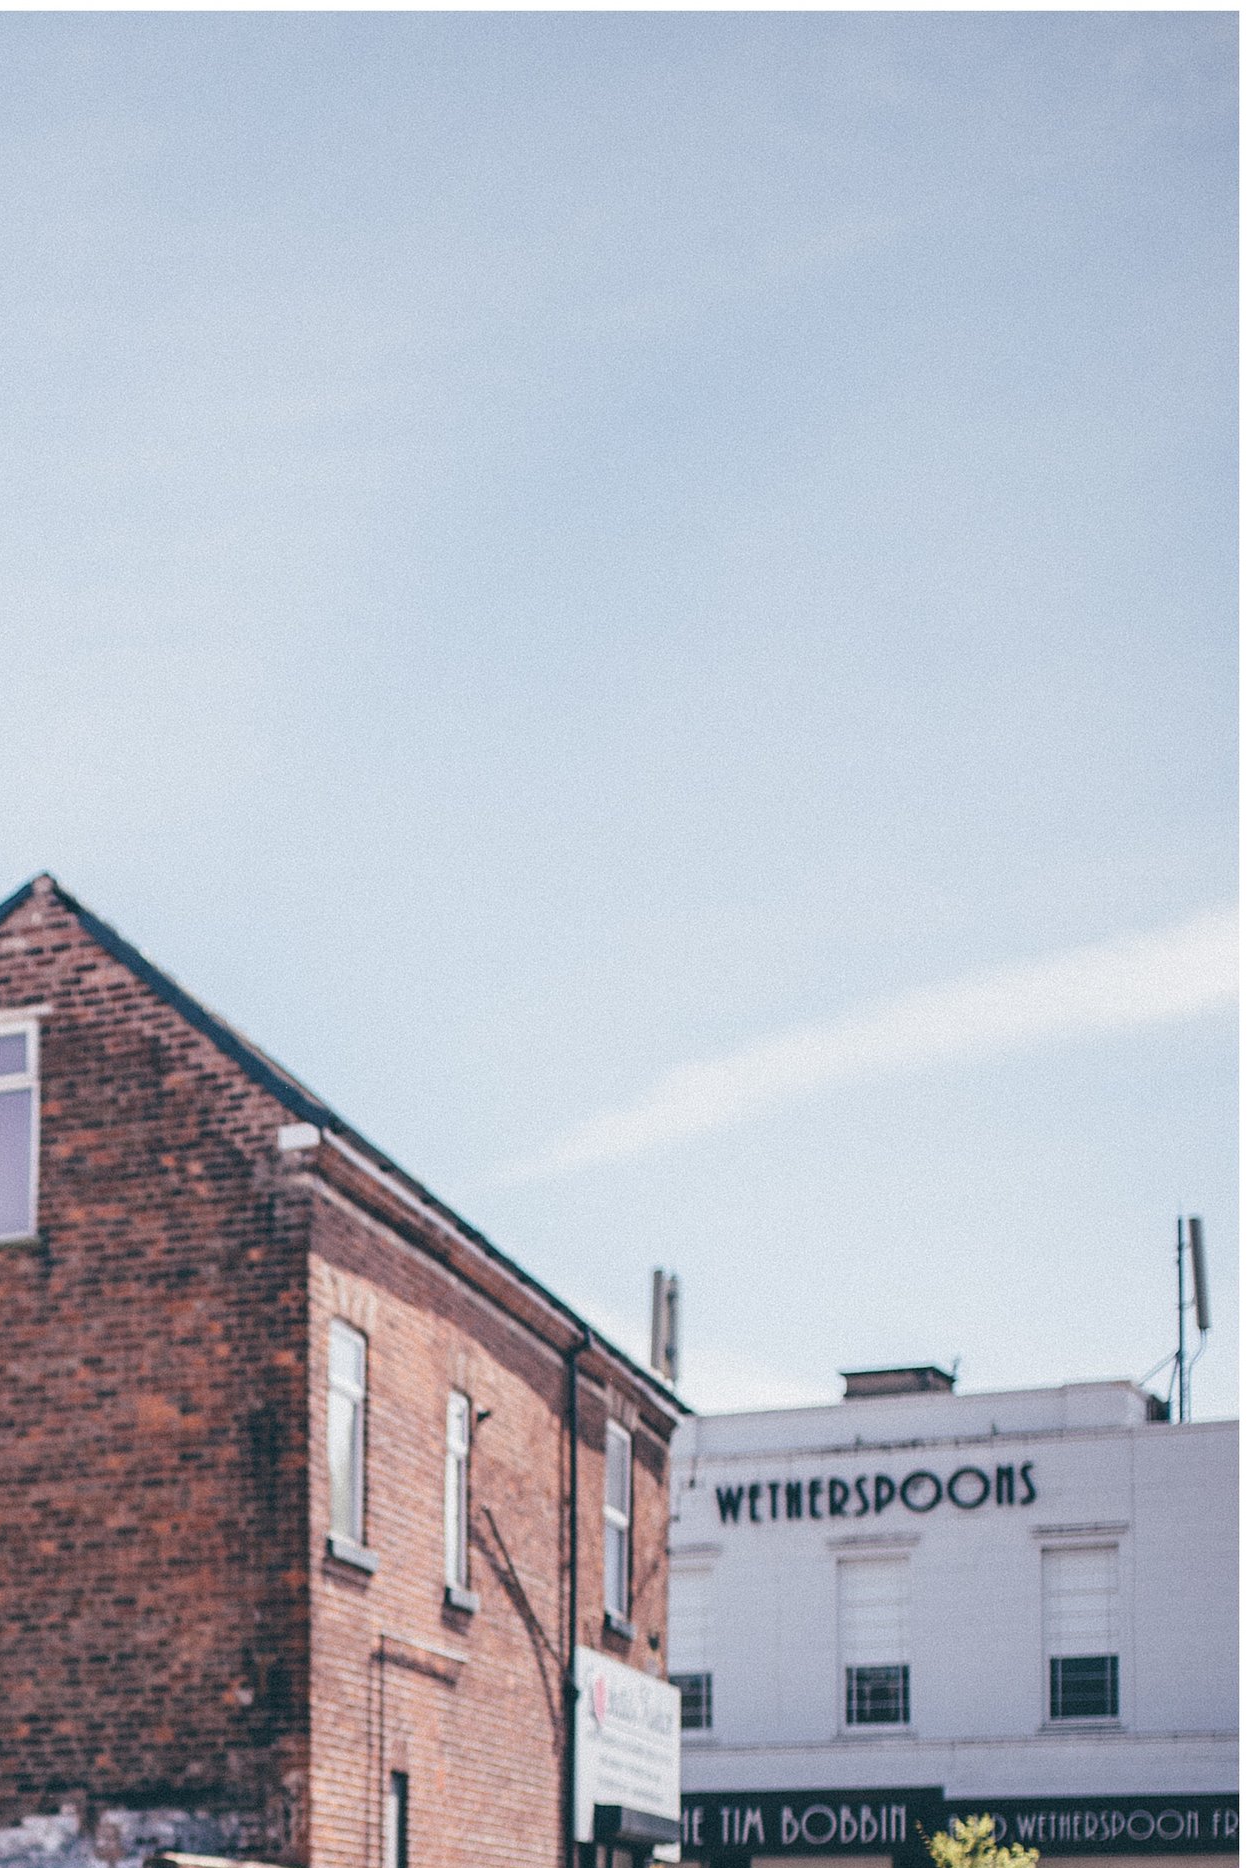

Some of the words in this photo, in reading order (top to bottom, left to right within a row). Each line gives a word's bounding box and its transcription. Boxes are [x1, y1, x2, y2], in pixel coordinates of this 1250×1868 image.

[715, 1460, 1037, 1524] WETHERSPOONS
[721, 1806, 765, 1845] TIM
[781, 1803, 906, 1845] BOBBIN
[1016, 1808, 1199, 1842] WETHERSPOON
